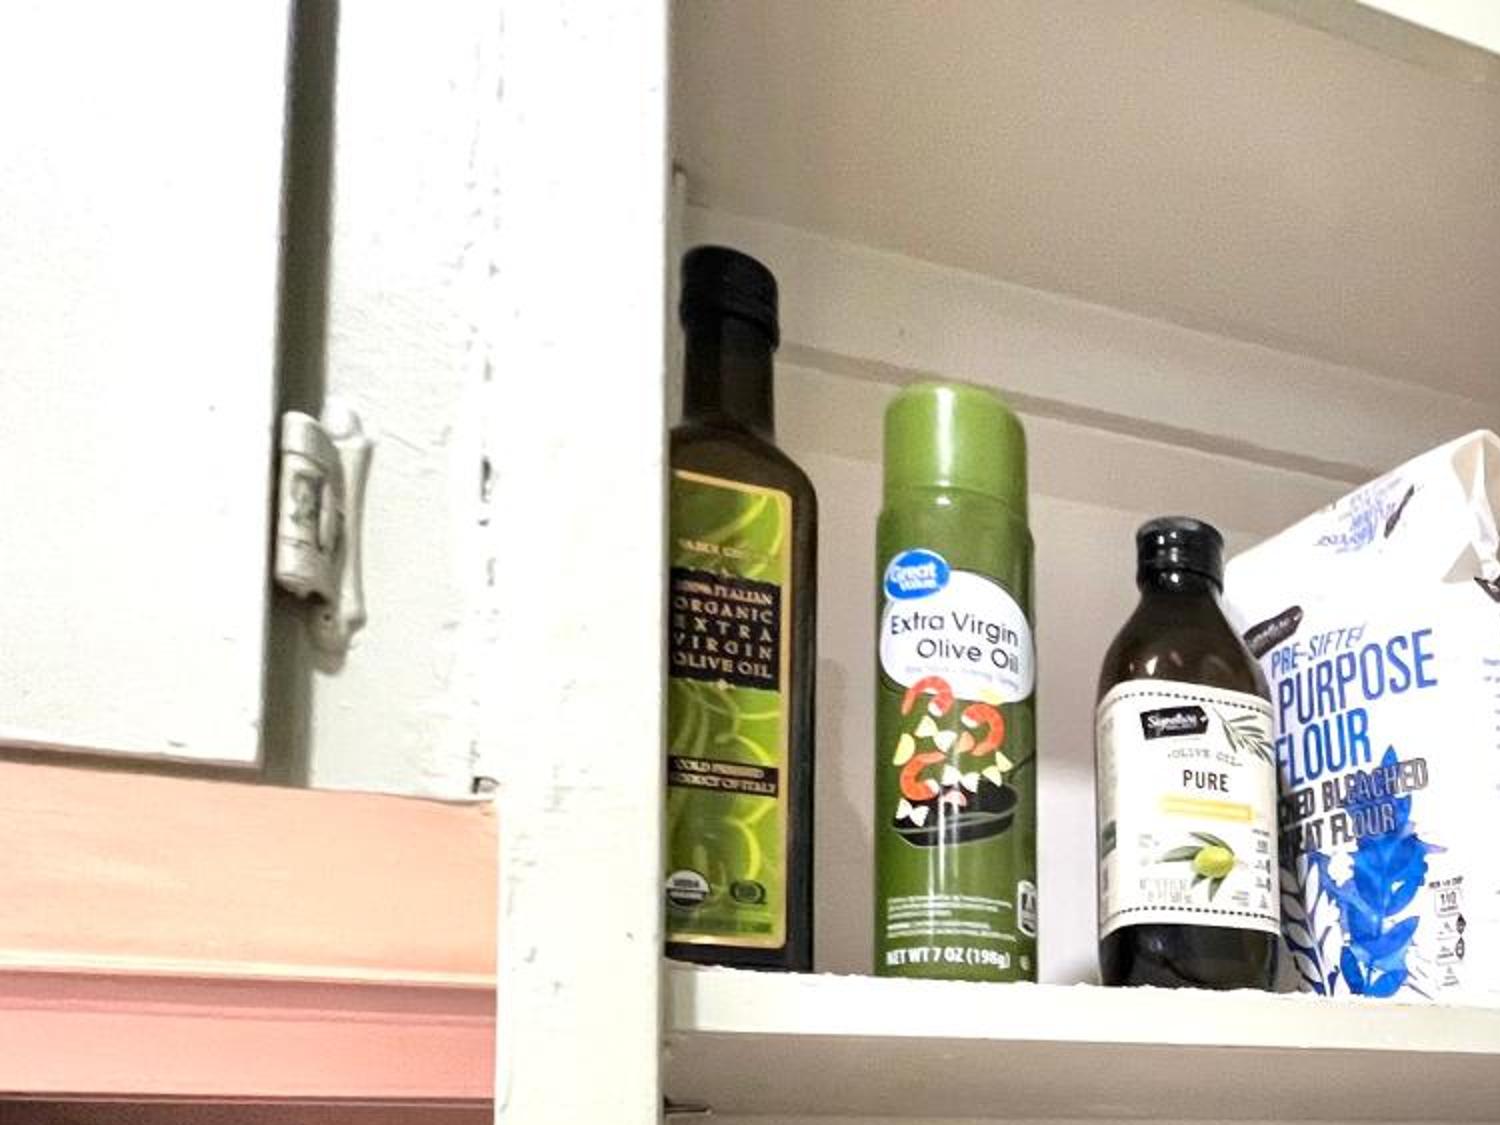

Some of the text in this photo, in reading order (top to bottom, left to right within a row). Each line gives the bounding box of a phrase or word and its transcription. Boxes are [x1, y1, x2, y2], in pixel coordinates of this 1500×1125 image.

[673, 596, 774, 625] ORGANIC
[673, 612, 773, 643] EXTRA
[673, 631, 773, 661] VIRGIN
[890, 610, 1019, 648] Extra Virgin
[672, 652, 772, 679] OLIVE OIL
[916, 637, 1019, 675] Olive Oil
[1278, 627, 1439, 736] PURPOSE
[1274, 707, 1373, 788] FLOUR
[1183, 769, 1230, 793] PURE
[1321, 757, 1429, 813] BLEACHED
[1330, 801, 1397, 848] FLOUR
[886, 950, 906, 966] NET
[907, 947, 930, 963] WT
[932, 947, 942, 962] 7
[943, 947, 965, 963] OZ
